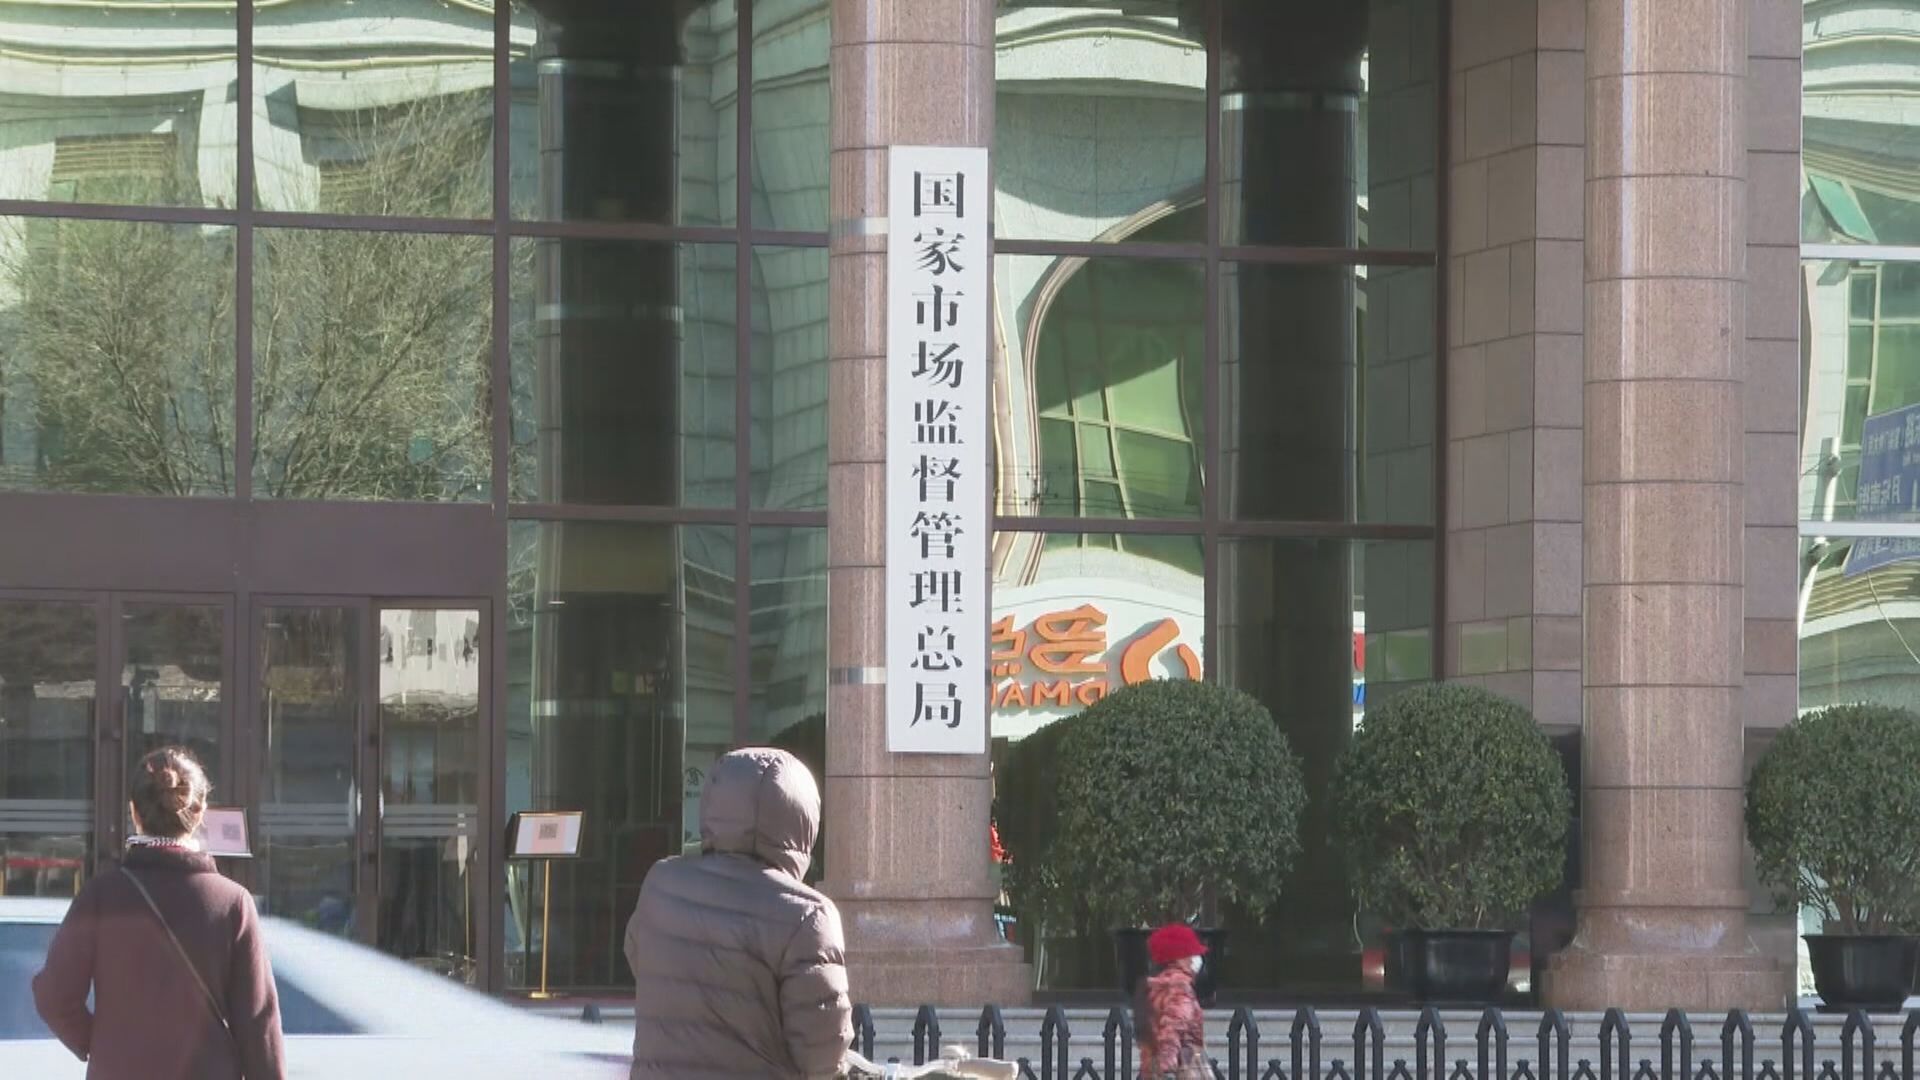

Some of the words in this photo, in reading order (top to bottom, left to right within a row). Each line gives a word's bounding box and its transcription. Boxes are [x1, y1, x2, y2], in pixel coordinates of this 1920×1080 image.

[910, 171, 966, 730] 国家市场监督管理总局
